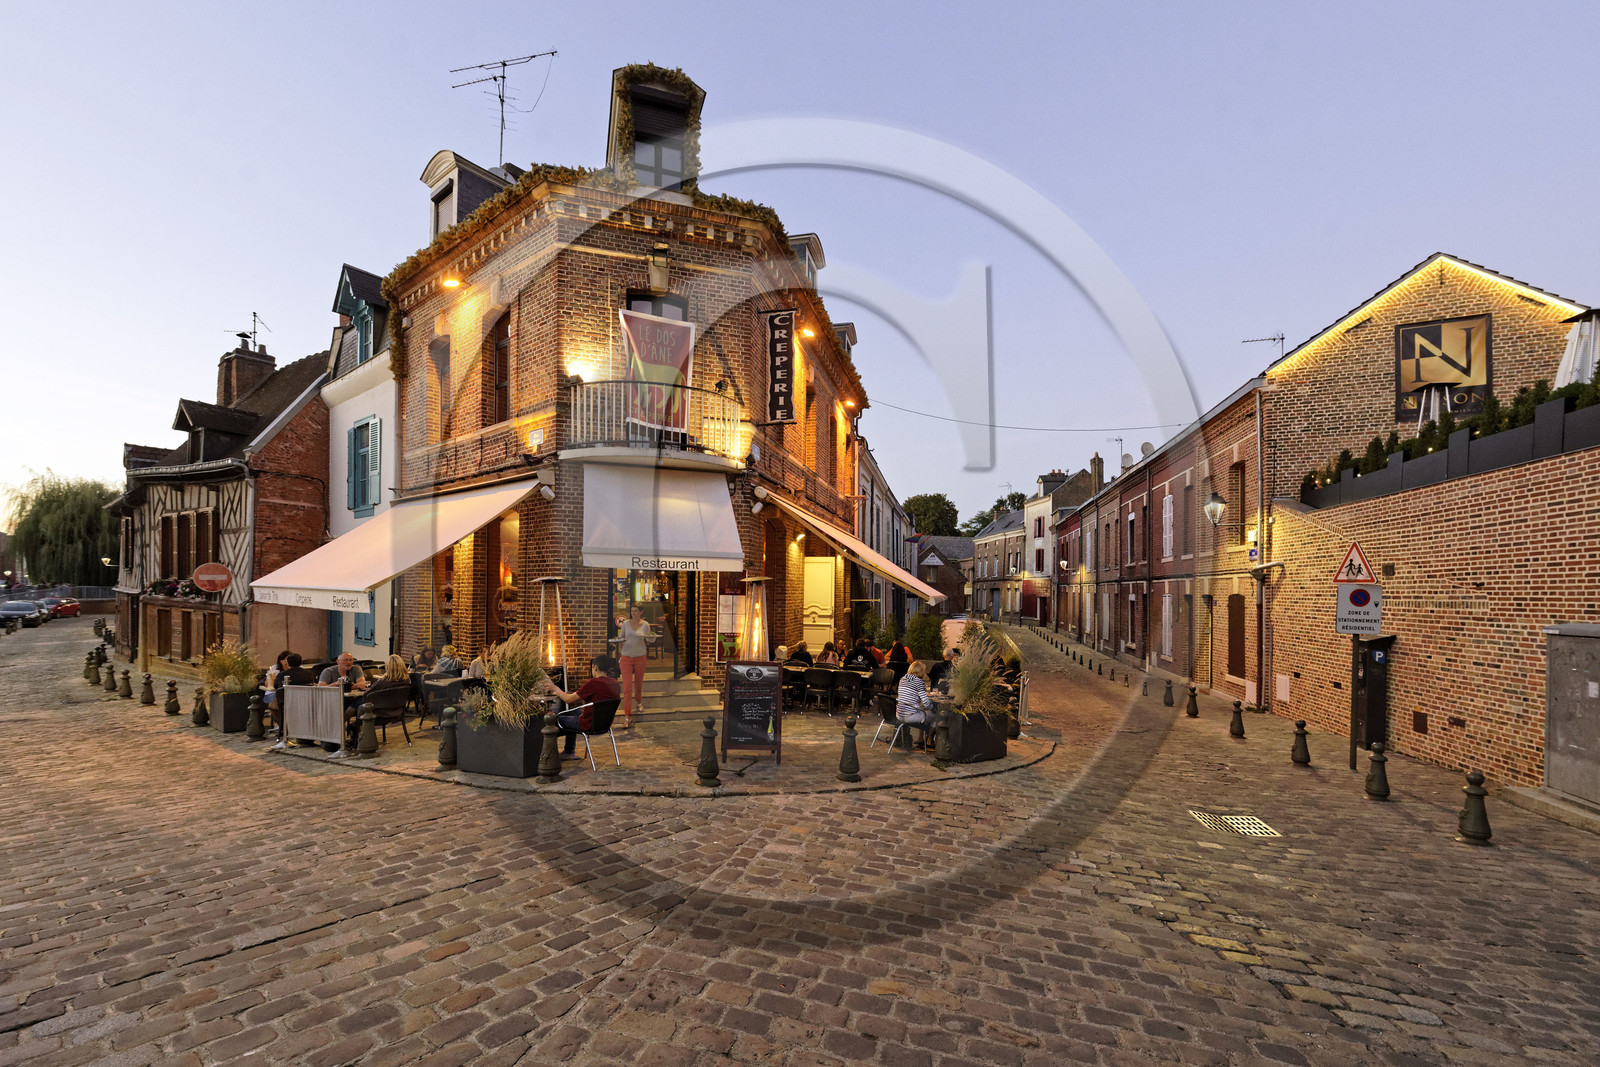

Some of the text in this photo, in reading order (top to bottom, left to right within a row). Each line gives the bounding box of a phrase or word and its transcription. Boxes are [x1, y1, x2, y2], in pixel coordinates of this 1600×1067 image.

[639, 324, 676, 347] LE DOS
[641, 342, 673, 364] D'ÂNE
[773, 315, 790, 419] CREPERIE
[631, 556, 700, 570] Restaurant
[332, 595, 360, 609] Restaurant
[1375, 651, 1384, 662] P
